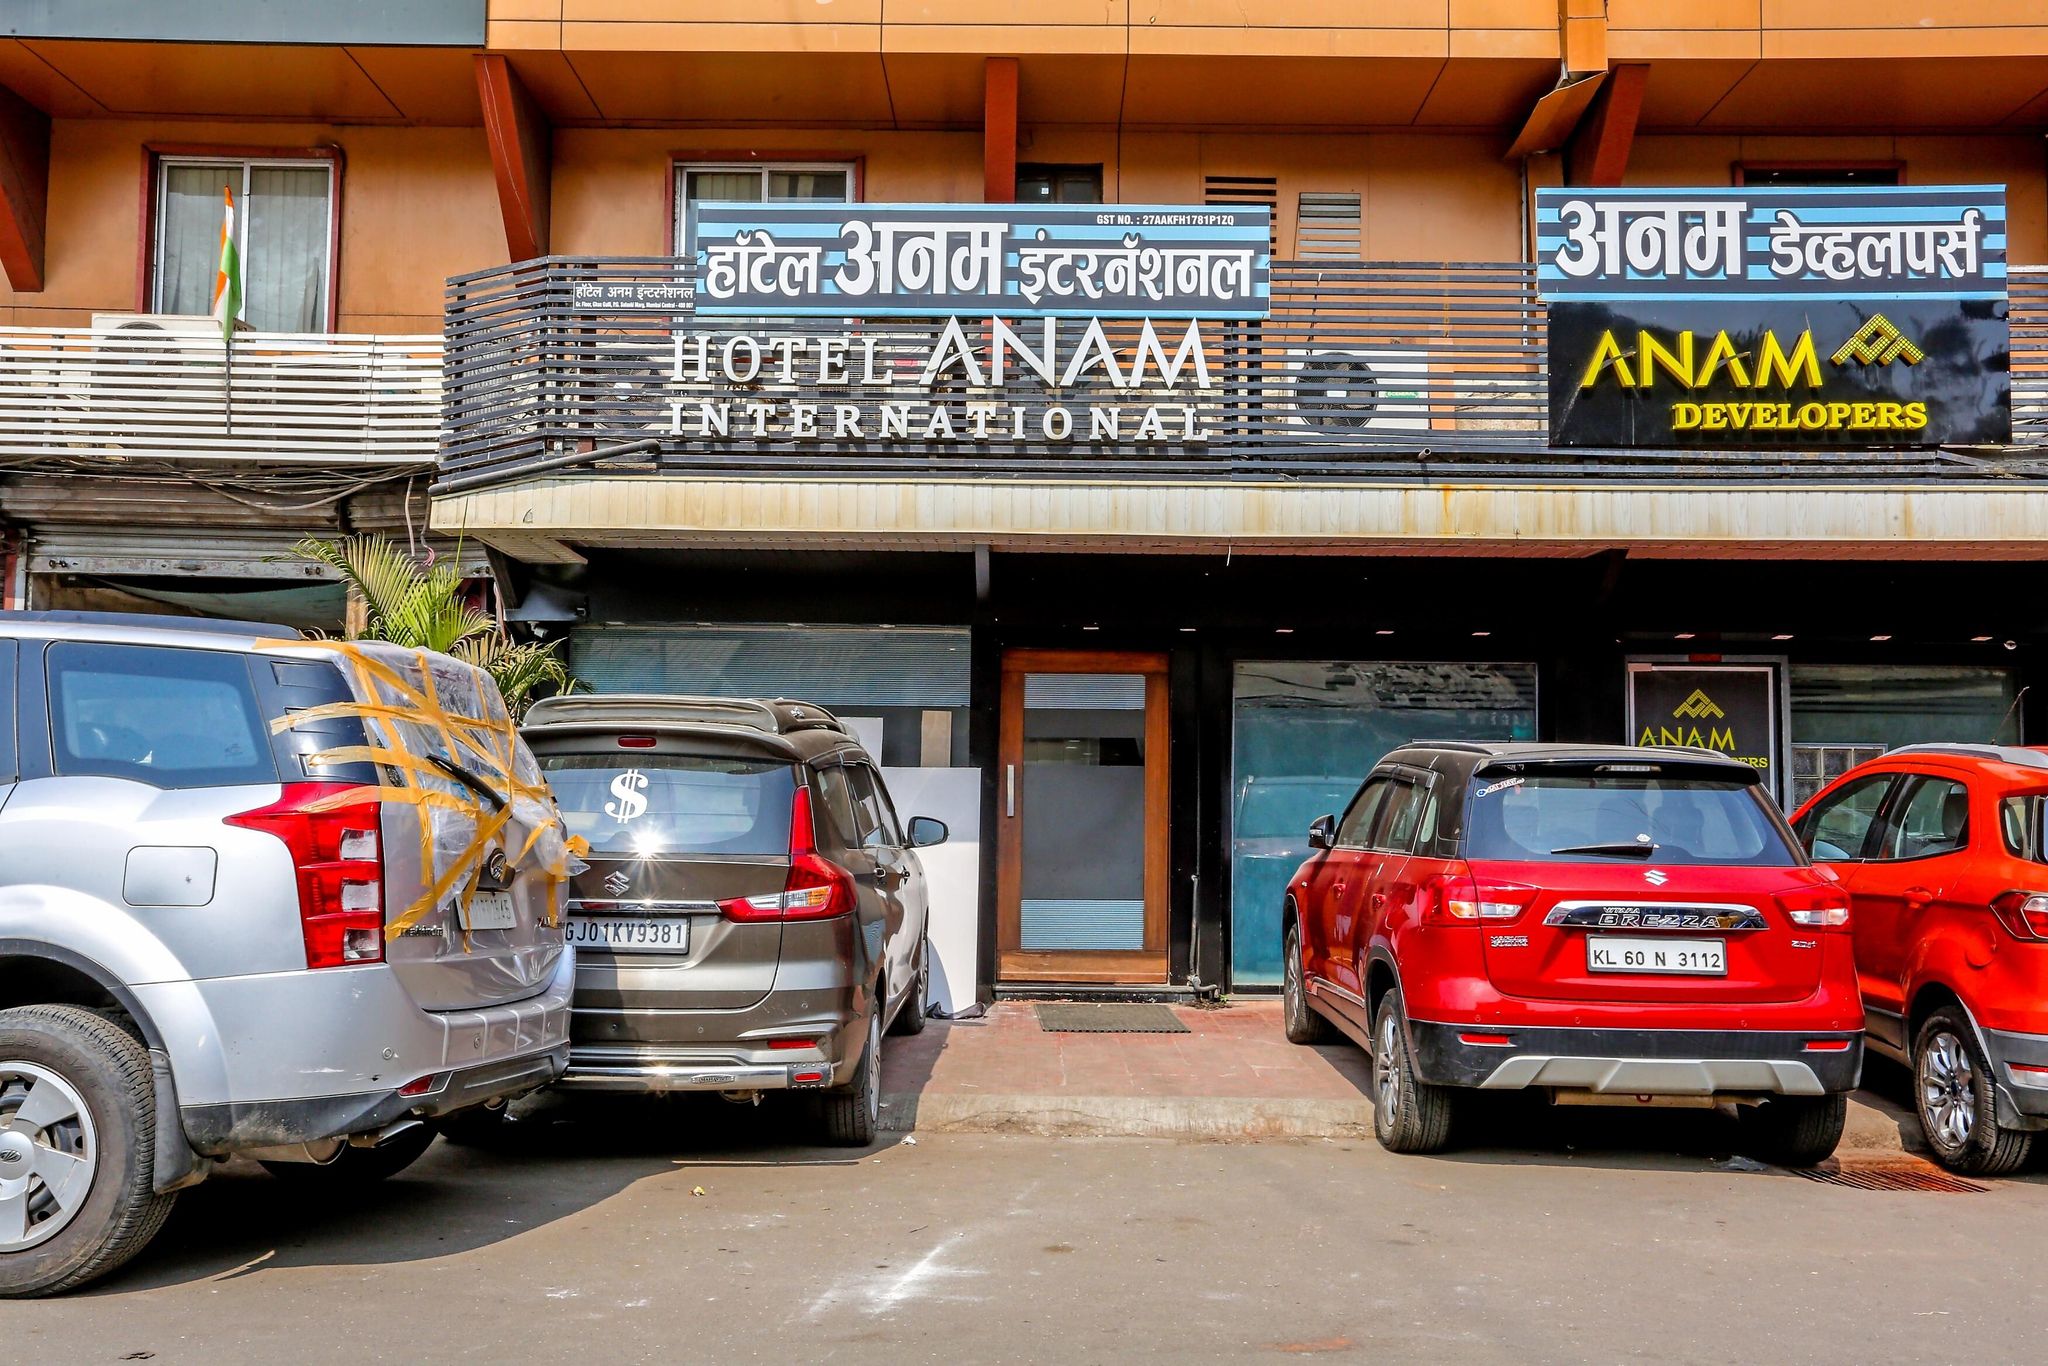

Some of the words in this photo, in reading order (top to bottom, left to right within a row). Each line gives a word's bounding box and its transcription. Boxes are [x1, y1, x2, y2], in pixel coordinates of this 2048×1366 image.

[1096, 214, 1116, 225] GST
[1117, 214, 1134, 225] NO.
[1142, 214, 1234, 225] 27AAKFH1781P1ZQ
[1555, 200, 1747, 276] अनम
[1769, 209, 1981, 279] डेव्हलपर्स
[706, 230, 822, 299] हॉटेल
[834, 220, 1008, 295] अनम
[576, 284, 603, 298] हॉटेल
[608, 286, 633, 298] अनम
[671, 335, 893, 385] HOTEL
[919, 314, 1211, 389] ANAM
[1580, 328, 1824, 389] ANAM
[669, 402, 1208, 442] INTERNATIONAL
[1673, 401, 1928, 431] DEVELOPERS
[1638, 726, 1735, 750] ANAM
[565, 922, 682, 944] GJ01KV9381
[1598, 914, 1720, 928] BREZZA
[1593, 949, 1617, 965] KL
[1624, 951, 1645, 966] 60
[1655, 951, 1667, 967] N
[1678, 953, 1720, 968] 3112
